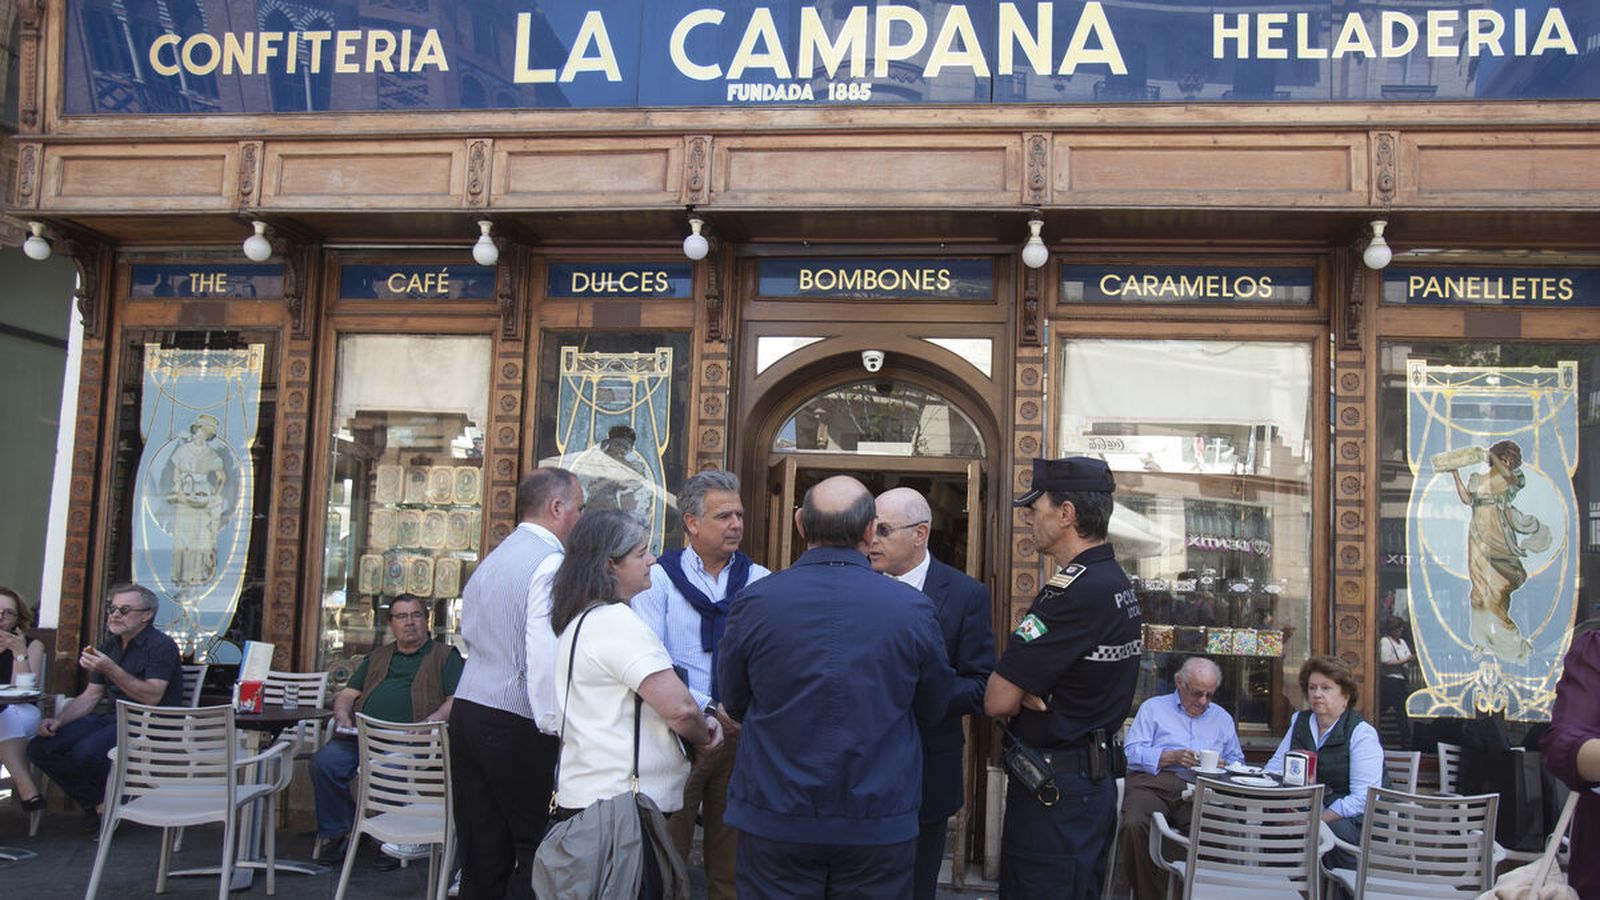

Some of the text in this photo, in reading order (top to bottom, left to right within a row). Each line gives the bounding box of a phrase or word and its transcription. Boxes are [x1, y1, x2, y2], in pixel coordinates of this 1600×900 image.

[513, 0, 1128, 83] LA CAMPANA
[1212, 8, 1577, 59] HELADERIA
[149, 29, 449, 75] CONFITERIA
[727, 82, 872, 101] FUNDADA 1885
[190, 273, 227, 293] THE
[388, 267, 449, 294] CAFÉ
[571, 271, 669, 293] DULCES
[800, 268, 951, 291] BOMBONES
[1100, 274, 1273, 299] CARAMELOS
[1408, 275, 1574, 301] PANELLETES
